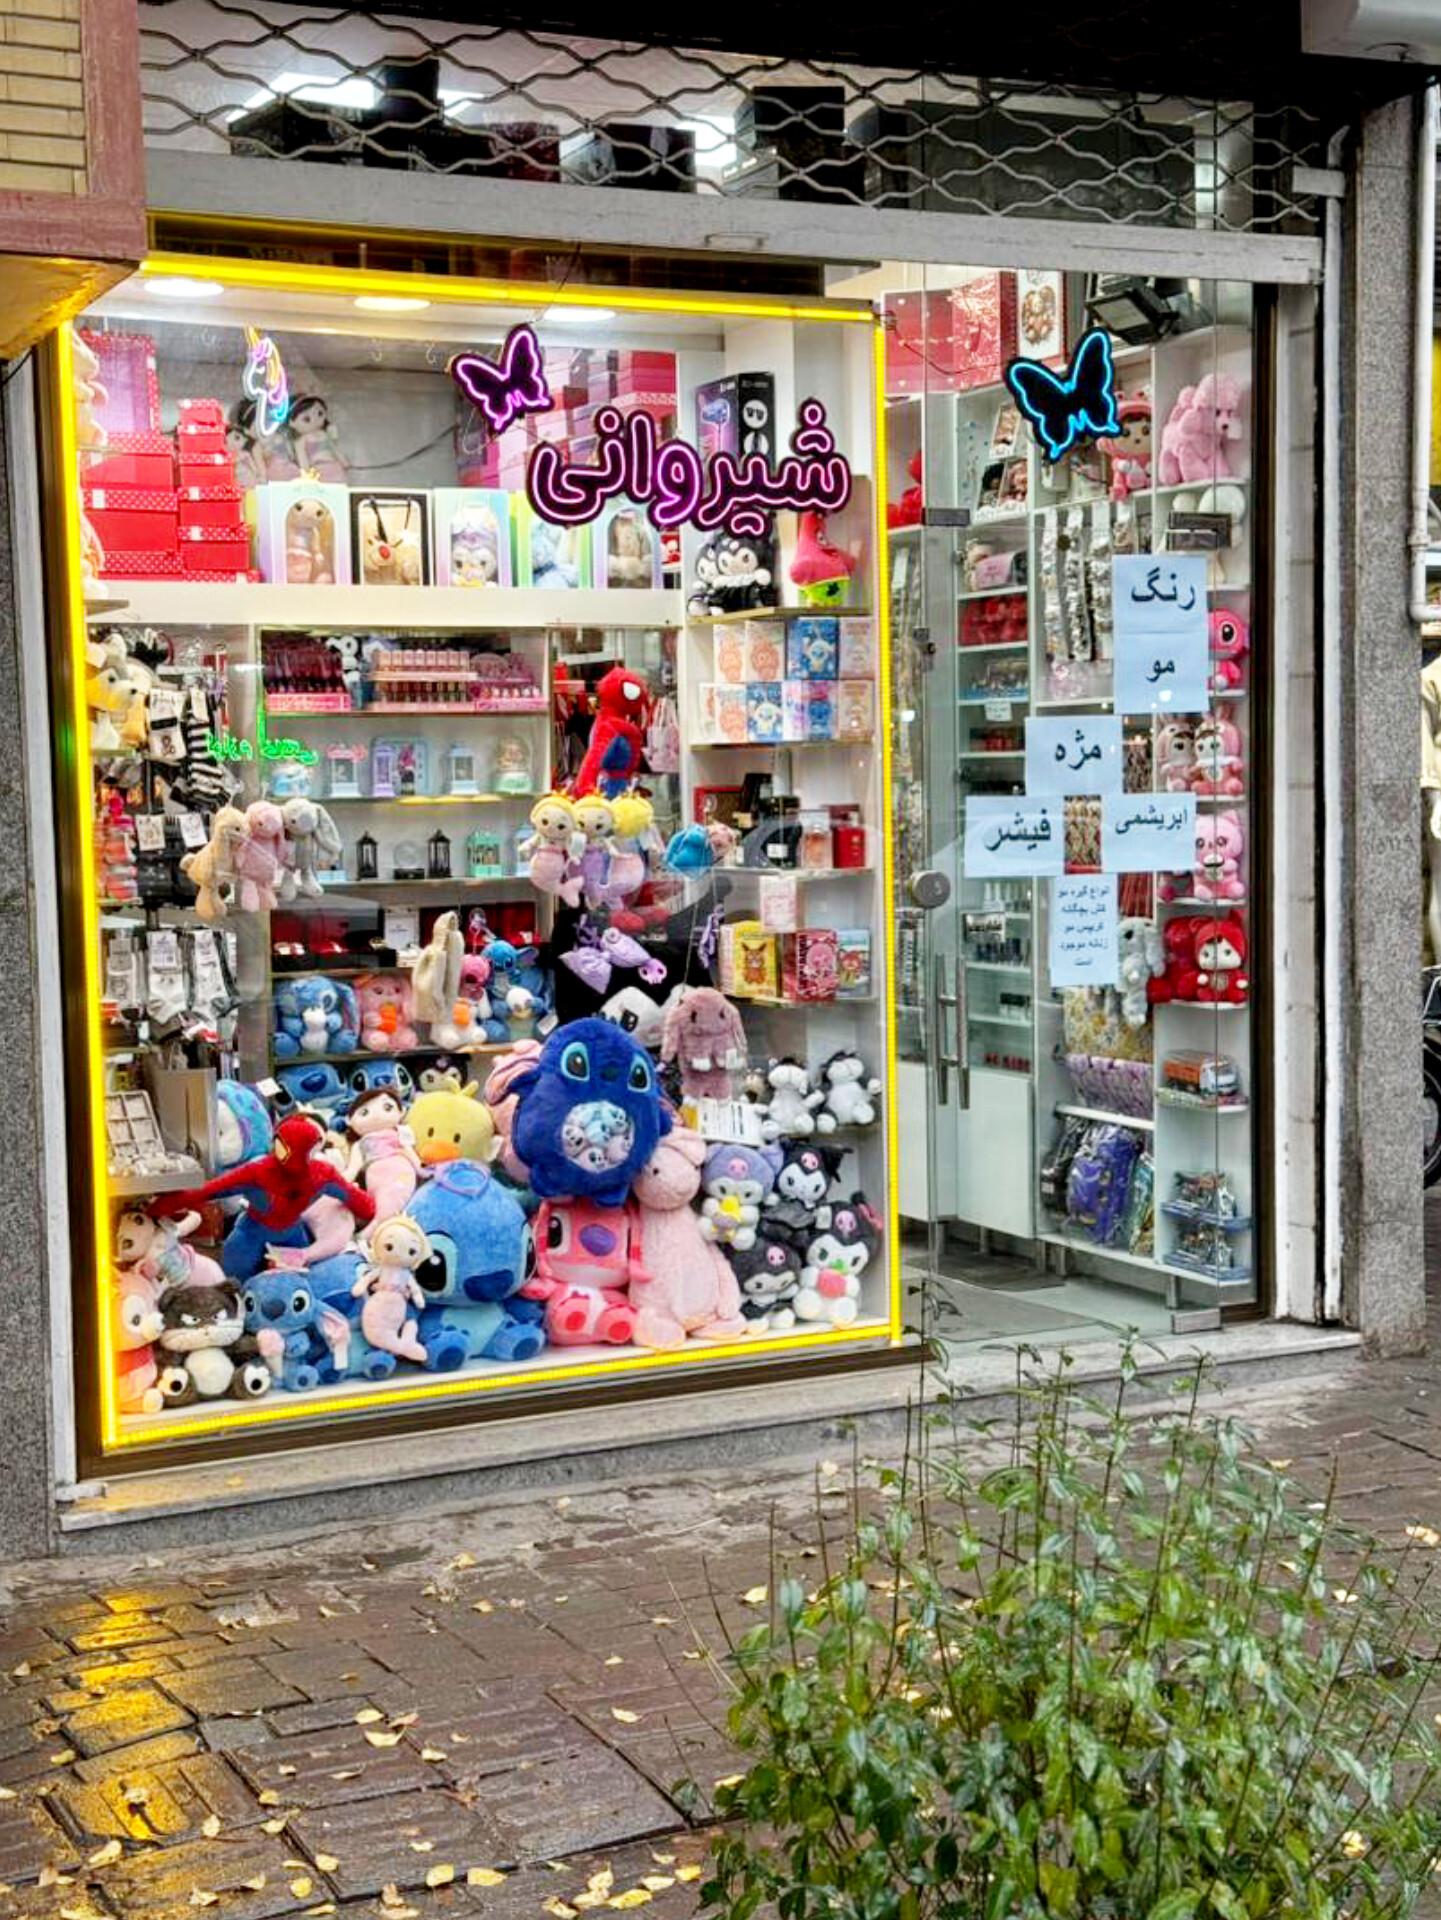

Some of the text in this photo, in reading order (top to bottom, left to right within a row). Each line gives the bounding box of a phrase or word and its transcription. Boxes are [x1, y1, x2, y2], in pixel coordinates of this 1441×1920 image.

[530, 400, 852, 538] شیروانی
[1130, 566, 1196, 611] رنگ
[1146, 658, 1176, 684] مو
[1054, 728, 1103, 772] مژه
[984, 807, 1053, 853] فیشر
[1114, 804, 1190, 836] ابریشمی
